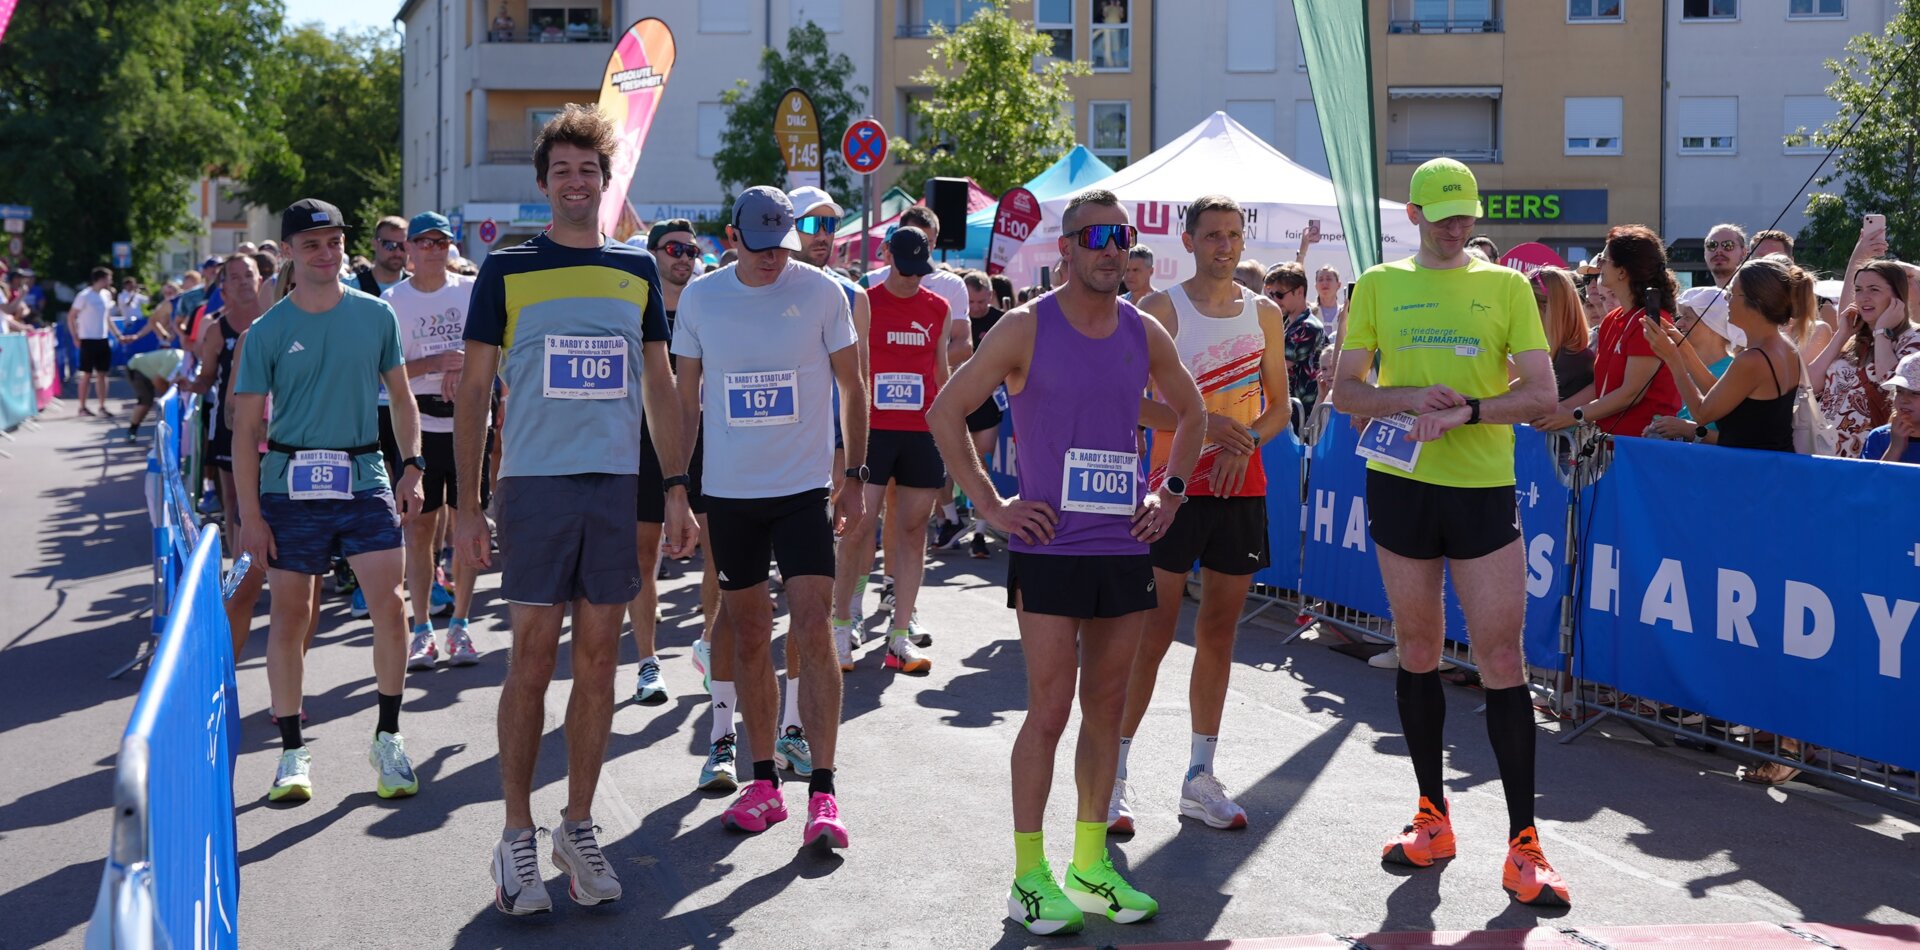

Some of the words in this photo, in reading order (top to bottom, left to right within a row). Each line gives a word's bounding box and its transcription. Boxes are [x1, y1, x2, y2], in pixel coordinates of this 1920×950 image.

[788, 143, 819, 167] 1:45
[1442, 184, 1462, 193] GORE
[1480, 194, 1560, 219] EERS
[998, 216, 1029, 239] 1:00
[1400, 303, 1425, 311] September
[886, 331, 926, 346] PUMA
[1411, 327, 1458, 336] friedberger
[1411, 336, 1480, 345] HALBMARATHON
[567, 357, 611, 379] 106
[582, 380, 595, 388] Joe
[886, 384, 913, 398] 204
[742, 389, 779, 409] 167
[1375, 425, 1397, 446] 51
[310, 466, 334, 483] 85
[1079, 470, 1128, 494] 1003
